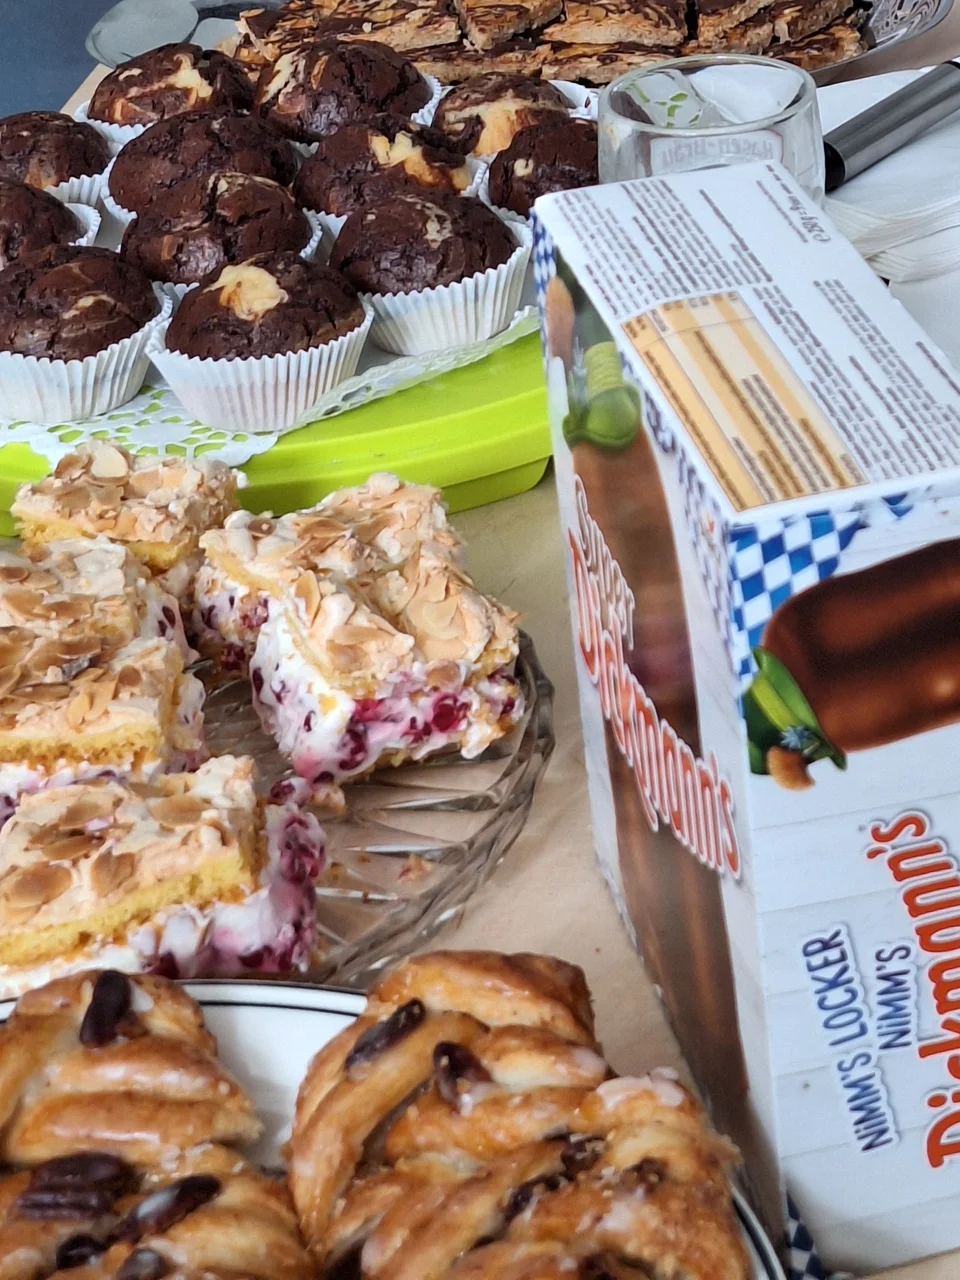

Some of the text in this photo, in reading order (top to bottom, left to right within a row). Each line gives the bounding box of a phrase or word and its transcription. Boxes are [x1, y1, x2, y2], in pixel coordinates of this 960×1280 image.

[573, 472, 636, 651] Super
[567, 526, 740, 881] Dickmann's
[802, 927, 869, 1048] LOCKER
